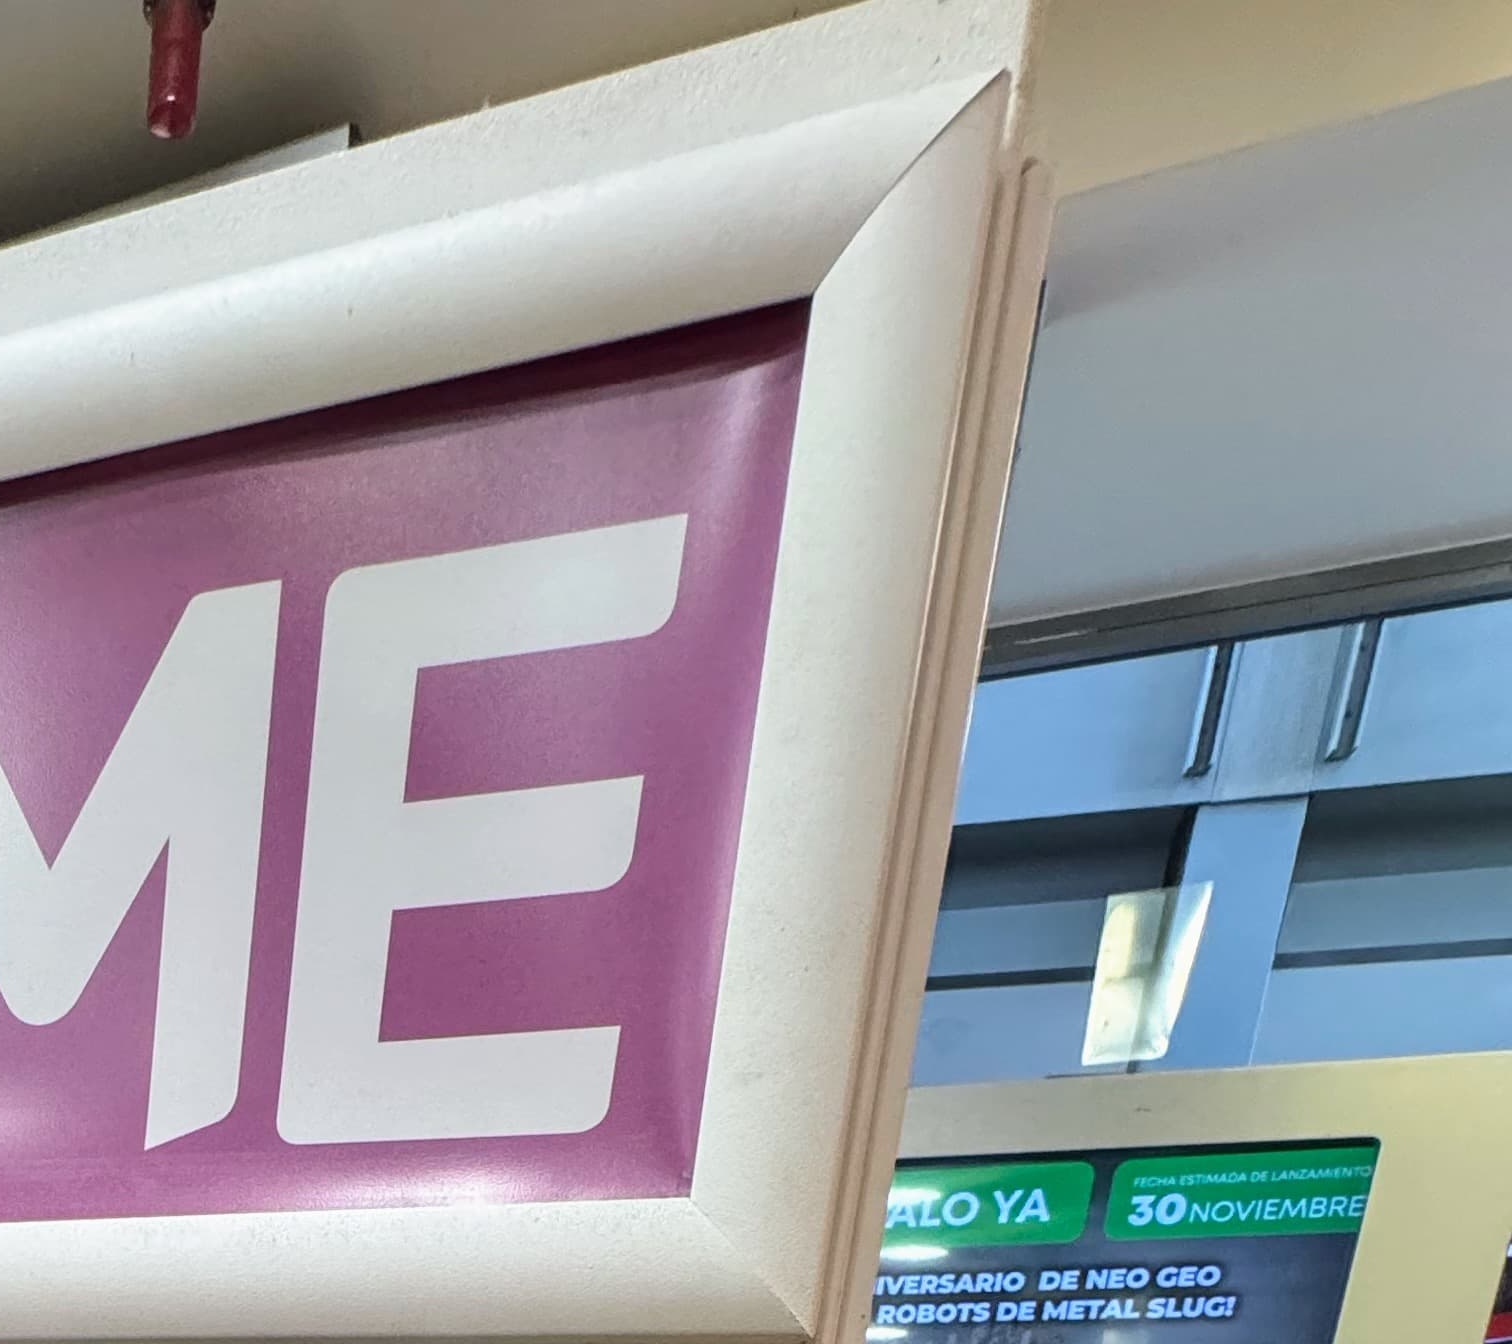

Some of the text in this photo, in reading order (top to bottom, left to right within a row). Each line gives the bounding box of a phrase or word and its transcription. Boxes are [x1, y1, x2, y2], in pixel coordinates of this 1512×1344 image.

[1133, 1175, 1177, 1189] FECHA
[1181, 1172, 1247, 1186] ESTIMADA
[1251, 1171, 1269, 1183] DE
[993, 1189, 1051, 1224] YA
[1127, 1194, 1366, 1226] 30 NOVIEMBRE
[1038, 1270, 1080, 1291] DE
[1085, 1268, 1150, 1290] NEO
[1156, 1265, 1222, 1287] GEO
[877, 1295, 1237, 1323] ROBOTS DE METAL SLUG!
